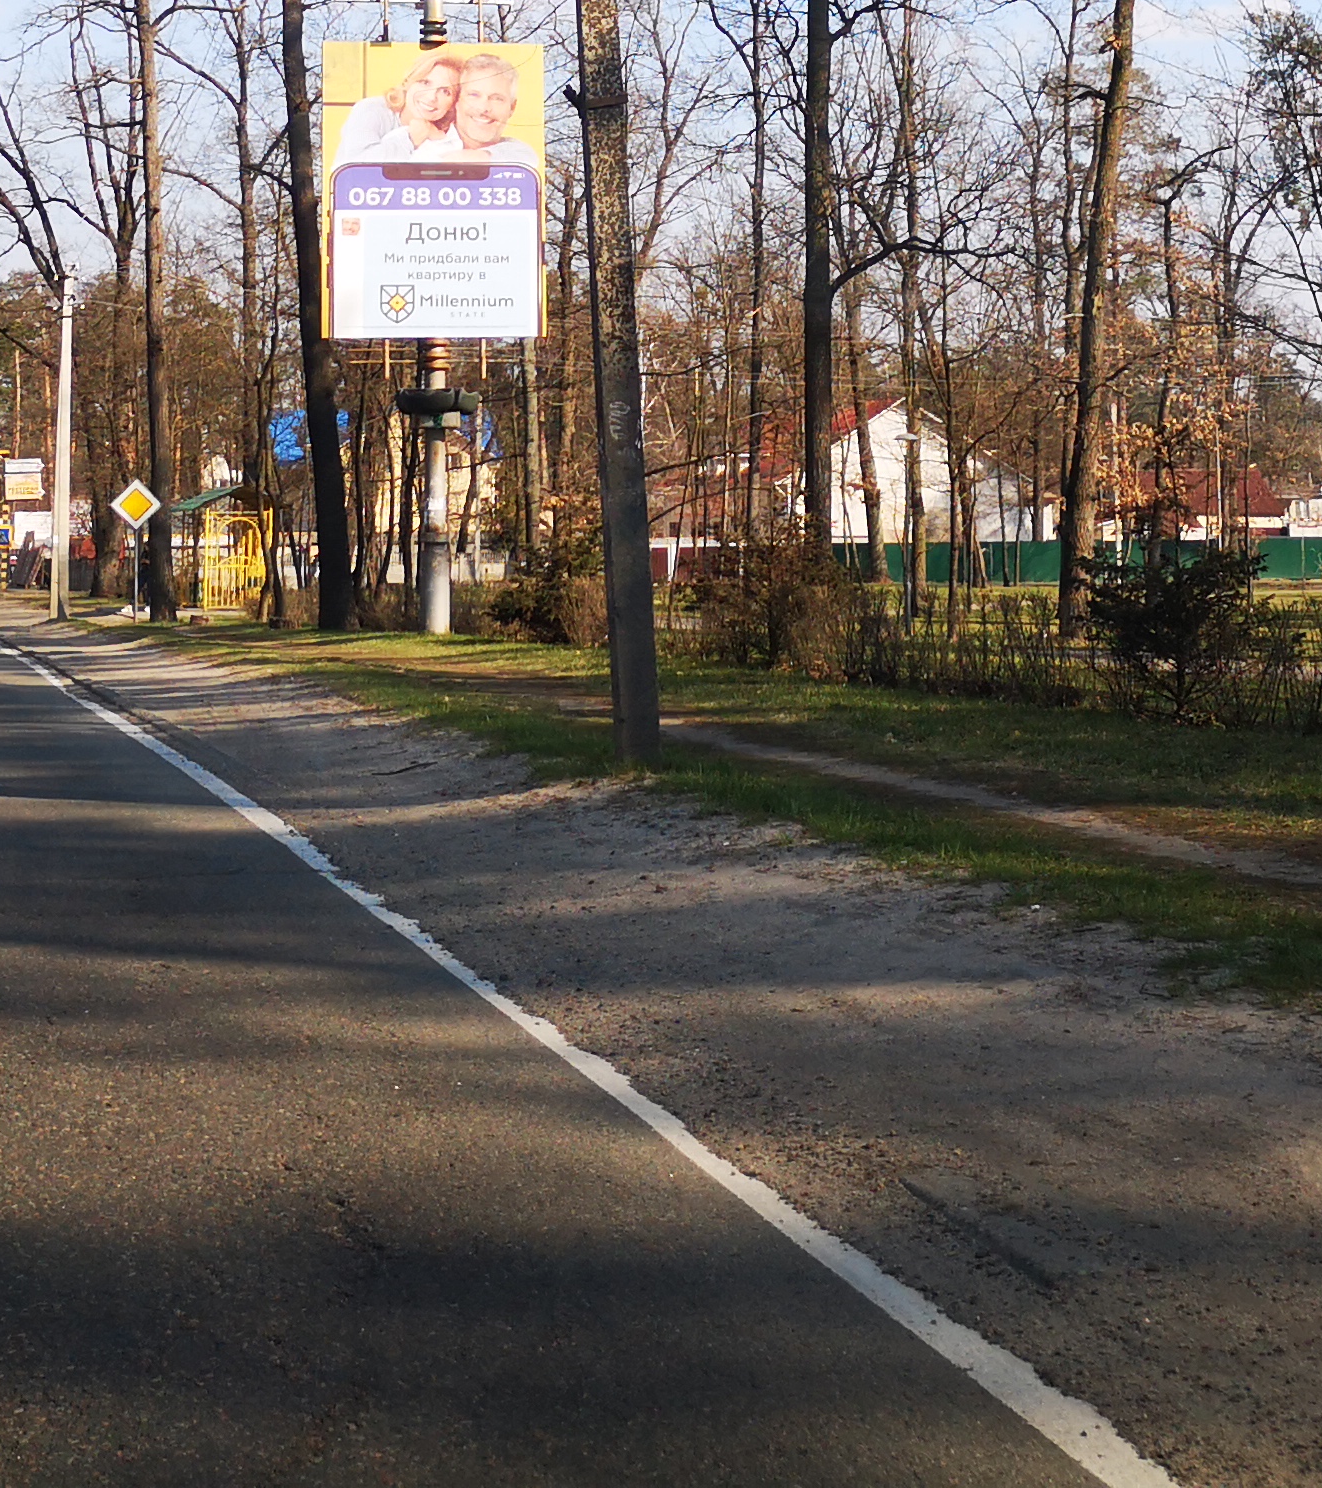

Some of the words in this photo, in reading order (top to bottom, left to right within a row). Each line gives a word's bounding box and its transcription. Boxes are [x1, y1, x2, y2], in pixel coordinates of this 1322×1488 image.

[348, 187, 395, 206] 067
[400, 187, 431, 206] 88
[437, 187, 472, 206] 00
[478, 187, 522, 206] 338
[405, 221, 488, 245] Доню!
[384, 253, 405, 264] Ми
[409, 252, 479, 265] придбали
[484, 254, 510, 264] вам
[407, 271, 474, 282] квартиру
[479, 271, 486, 280] в
[419, 294, 514, 307] Millennium
